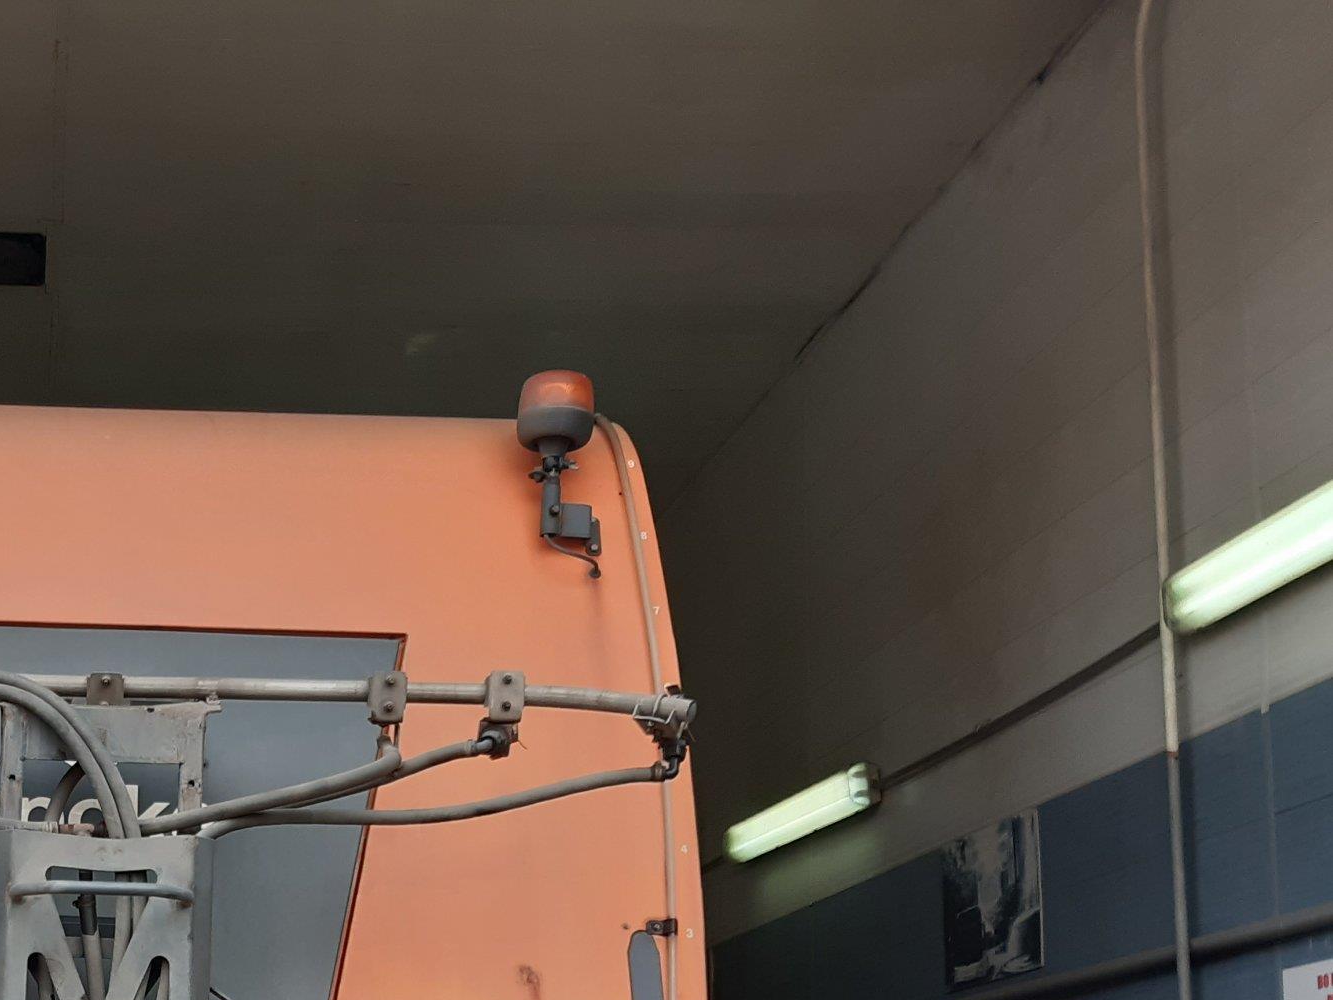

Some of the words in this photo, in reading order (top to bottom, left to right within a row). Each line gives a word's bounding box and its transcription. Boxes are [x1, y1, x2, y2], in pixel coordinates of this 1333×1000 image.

[628, 460, 635, 469] 9
[640, 531, 647, 540] 8
[652, 606, 660, 615] 7
[686, 928, 693, 938] 3
